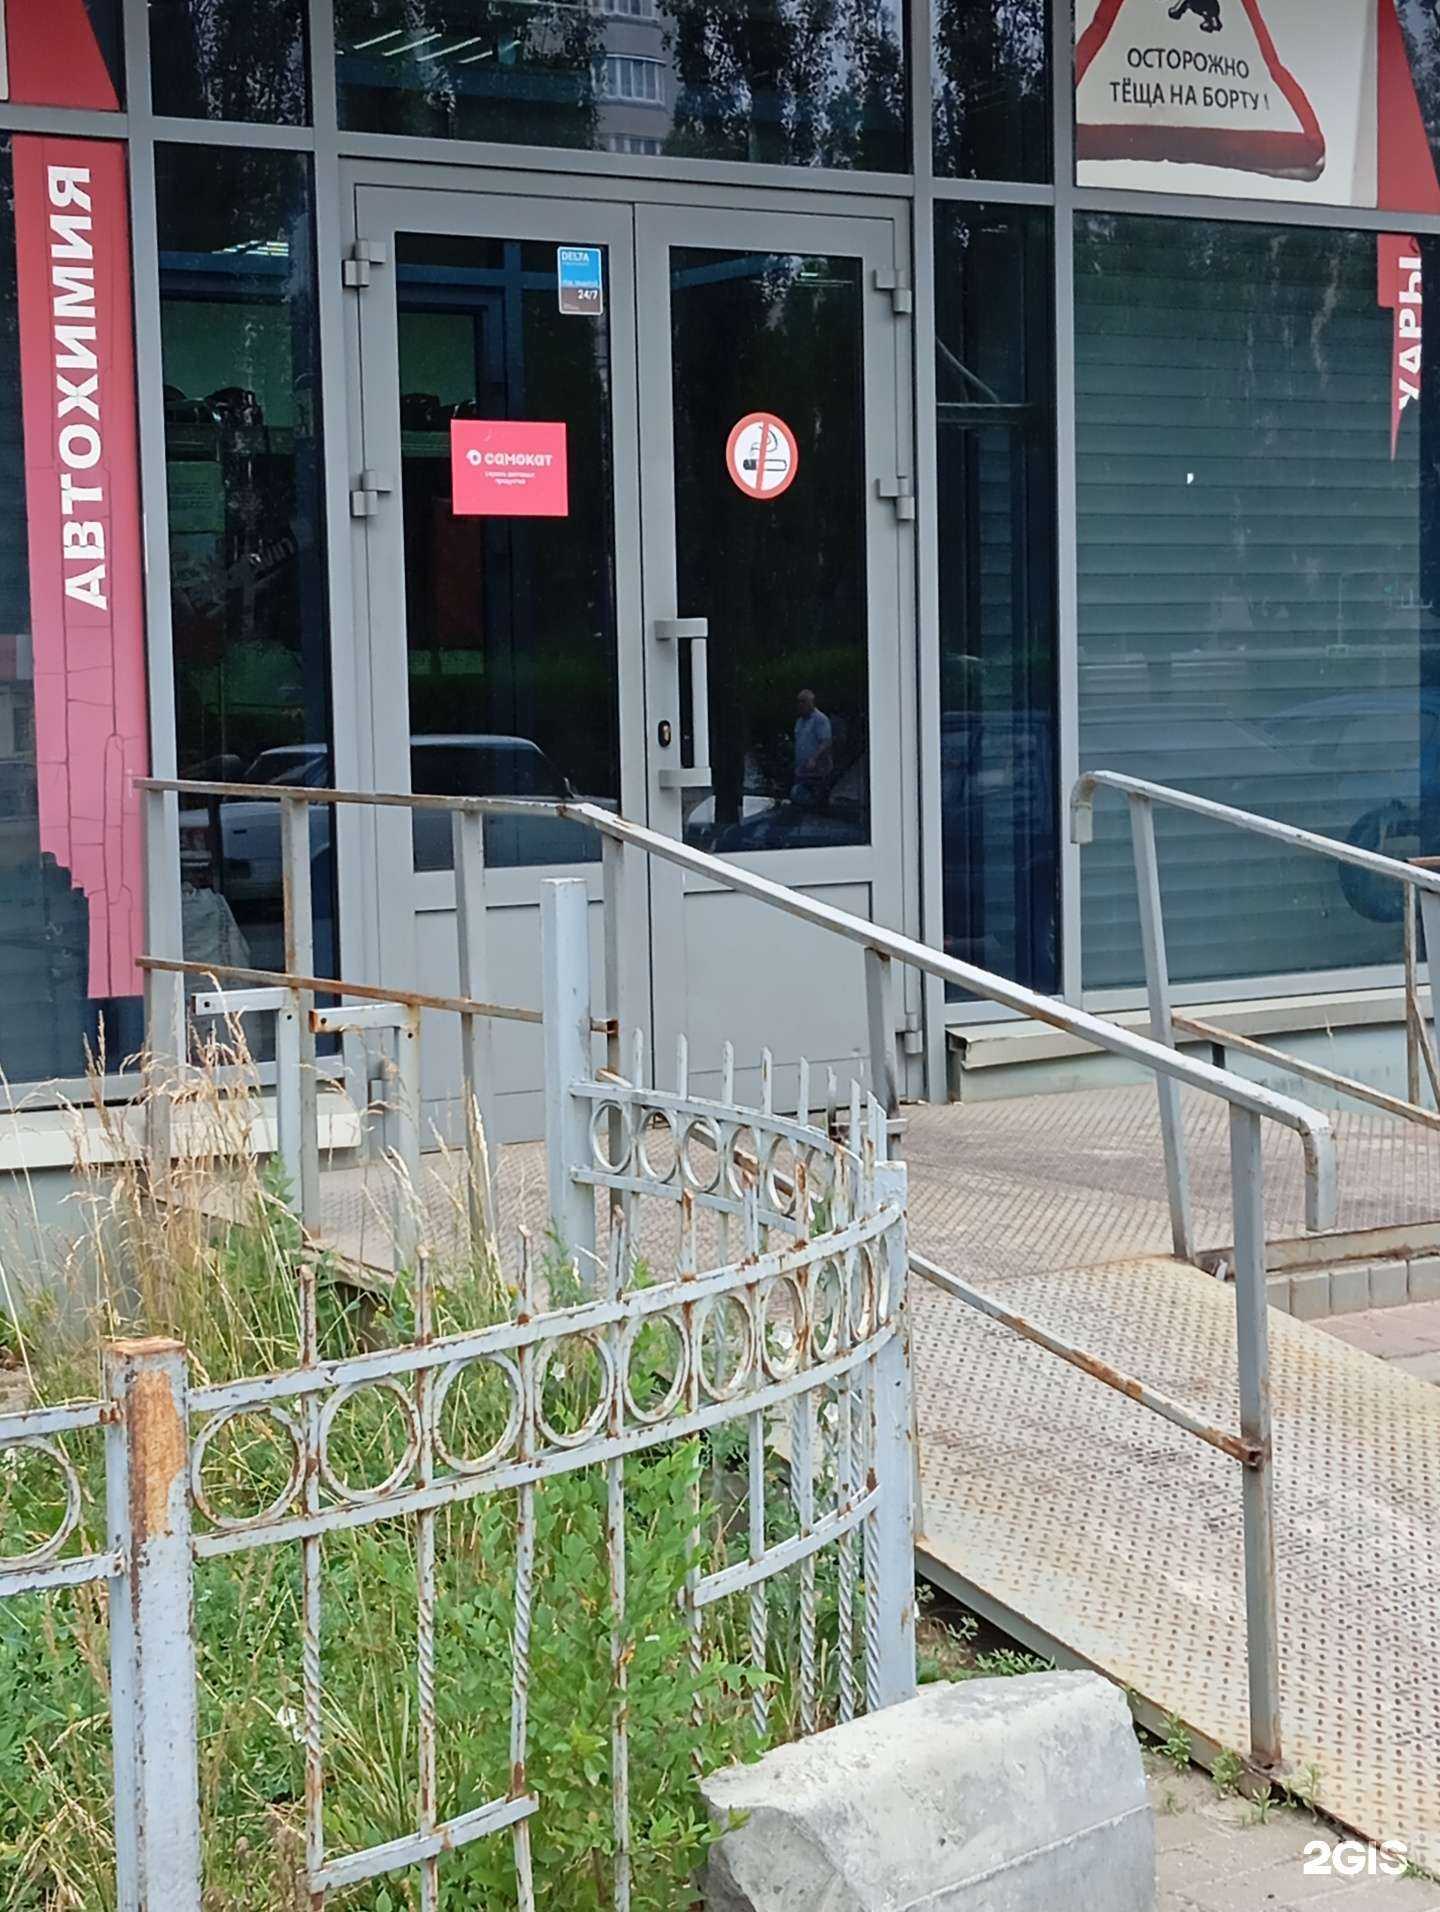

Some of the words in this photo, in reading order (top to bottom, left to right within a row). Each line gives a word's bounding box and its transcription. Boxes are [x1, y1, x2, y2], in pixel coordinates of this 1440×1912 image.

[1127, 48, 1249, 79] ОСТОРОЖНО
[1110, 78, 1165, 108] ТЁЩА
[1170, 84, 1197, 106] НА
[561, 250, 589, 263] DELTA
[48, 164, 108, 611] АВТОХИМИЯ
